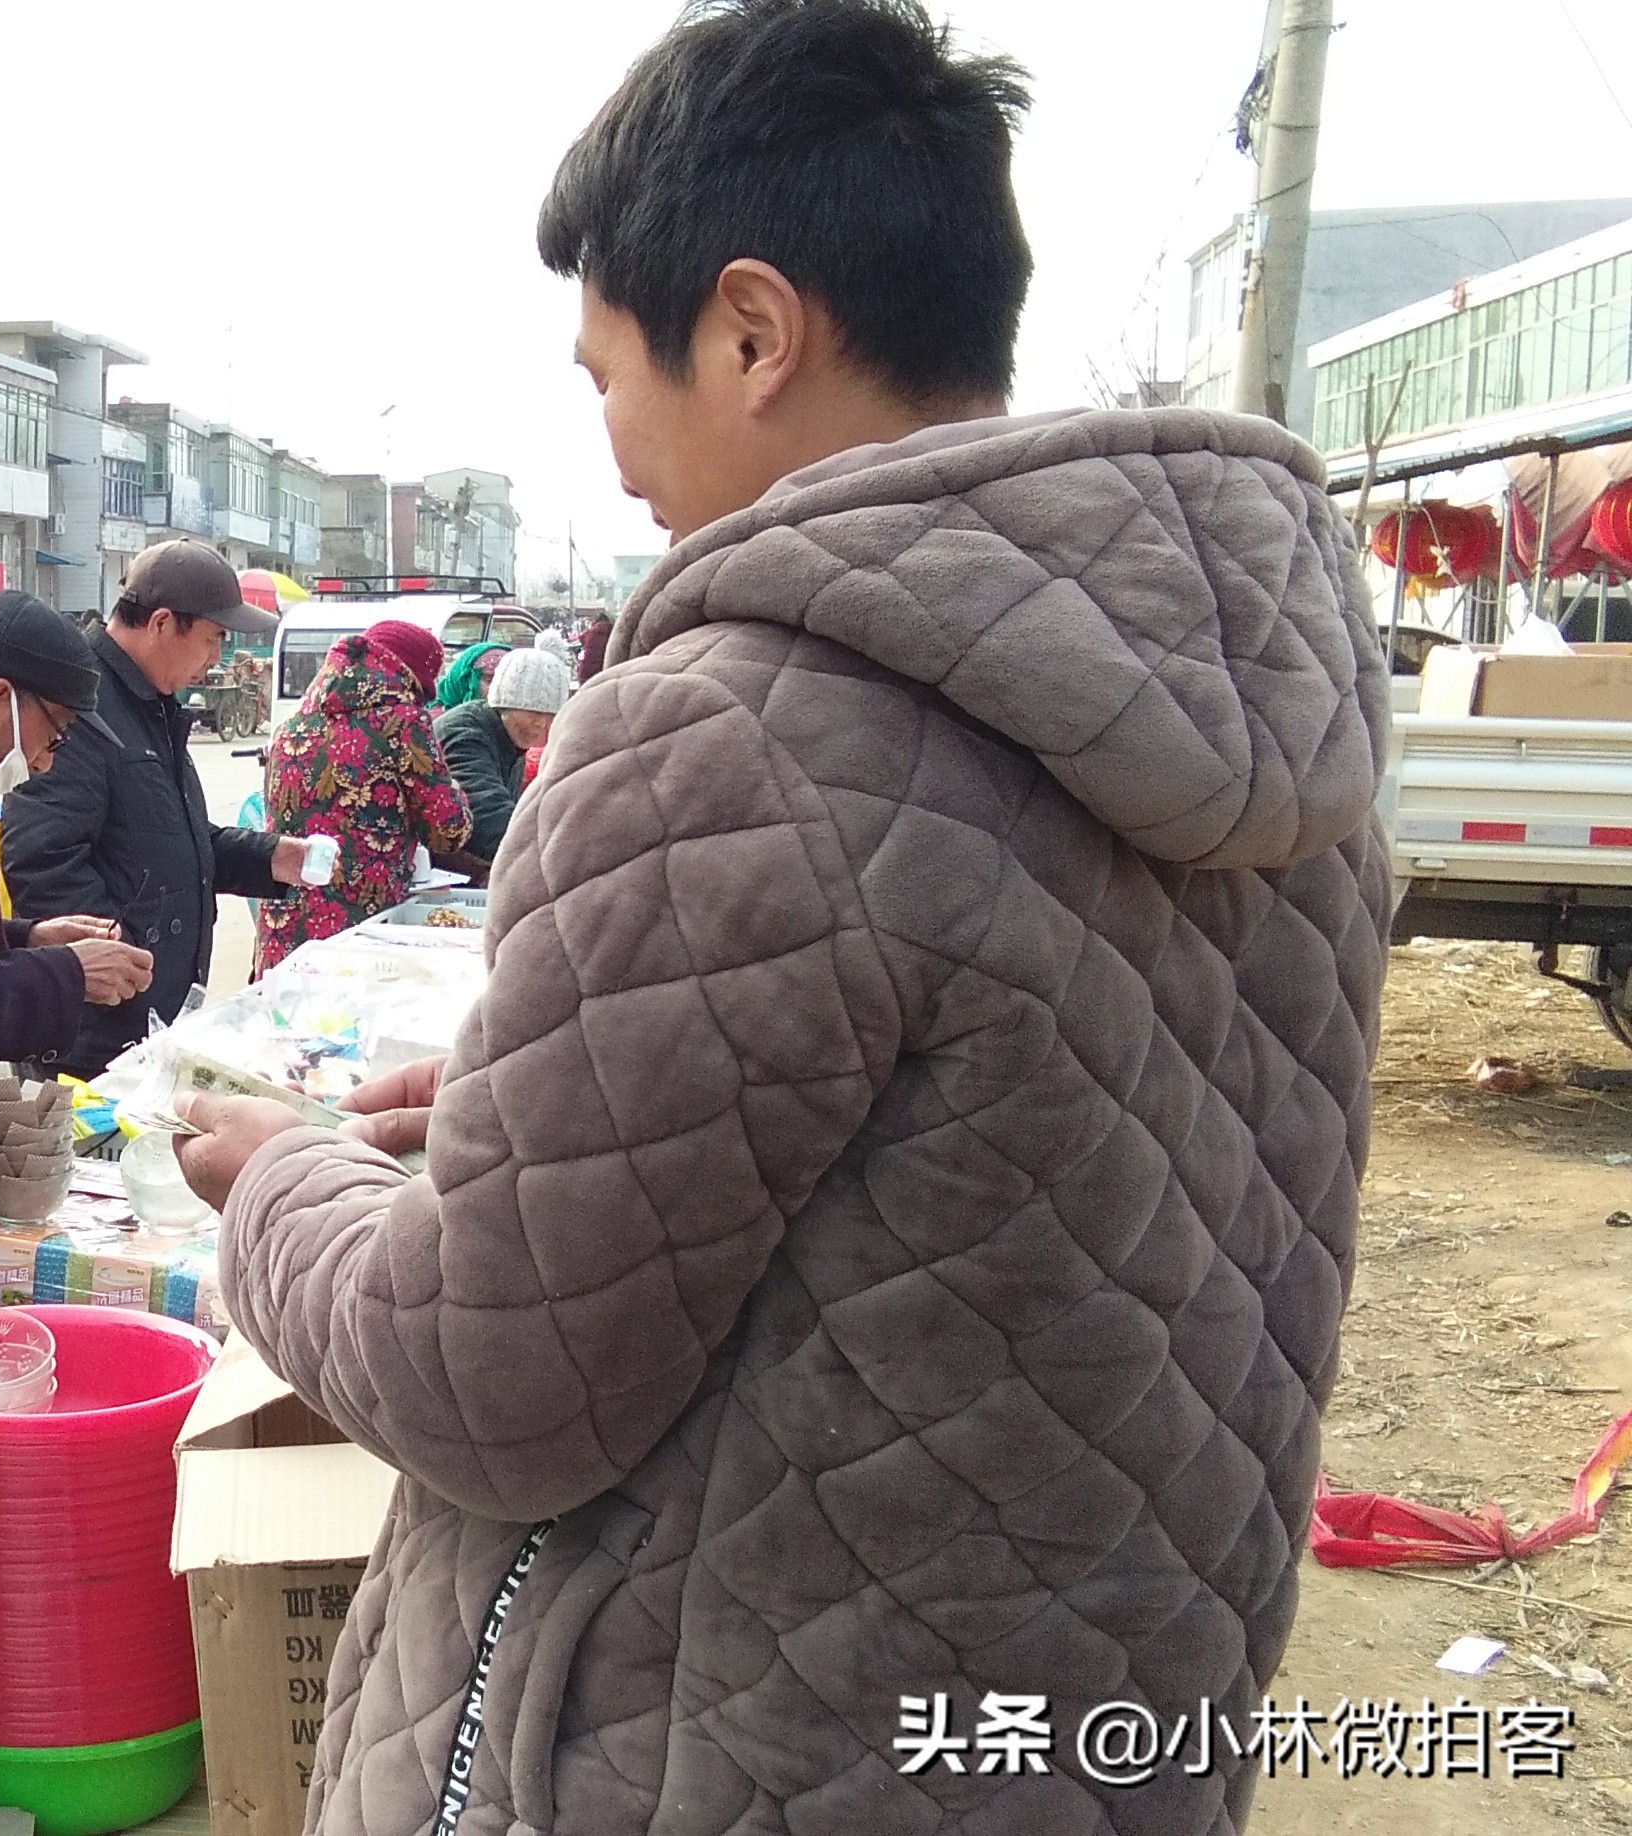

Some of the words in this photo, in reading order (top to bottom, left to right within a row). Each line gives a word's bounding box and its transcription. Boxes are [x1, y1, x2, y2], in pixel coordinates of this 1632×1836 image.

[282, 1583, 360, 1620] 器皿
[285, 1636, 323, 1662] KG
[288, 1677, 328, 1704] KG
